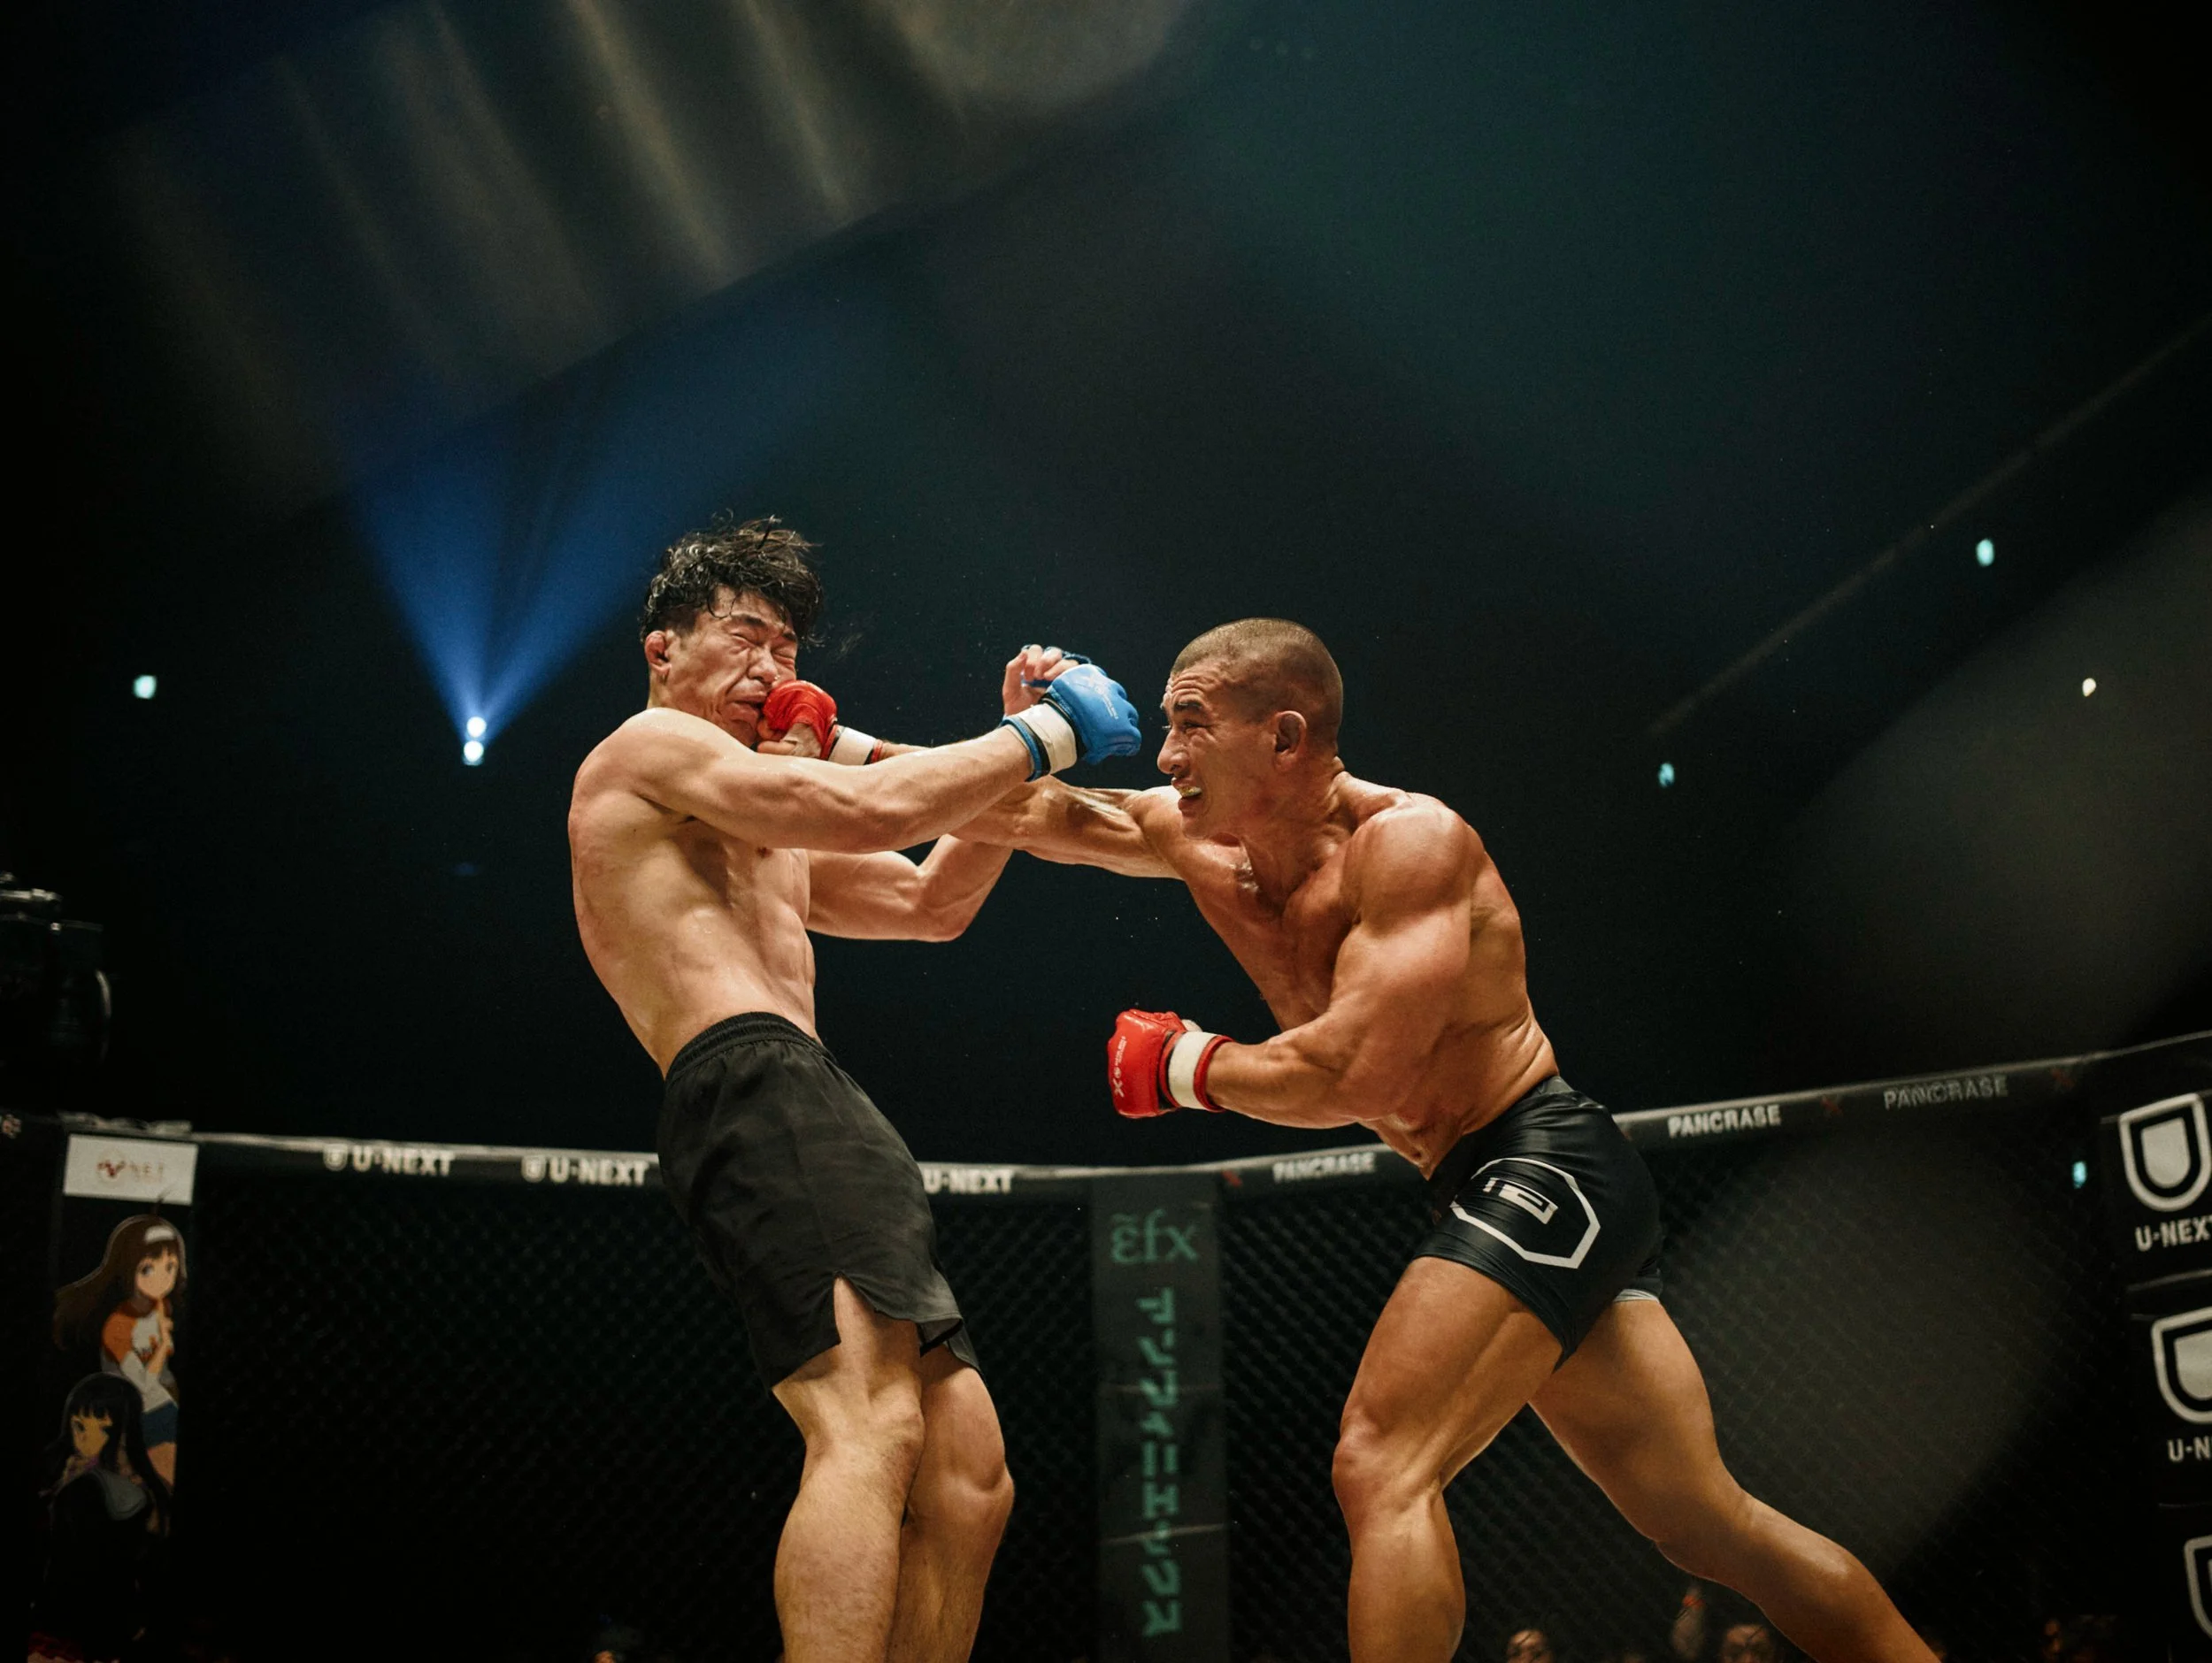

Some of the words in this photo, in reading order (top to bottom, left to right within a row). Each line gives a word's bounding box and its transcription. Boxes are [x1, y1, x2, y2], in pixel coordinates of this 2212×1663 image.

[1883, 1073, 2008, 1111] PANCRASE
[1667, 1104, 1781, 1139] PANCRASE
[1272, 1152, 1377, 1184] PANCRASE
[1135, 1285, 1184, 1639] アンフィニエックス
